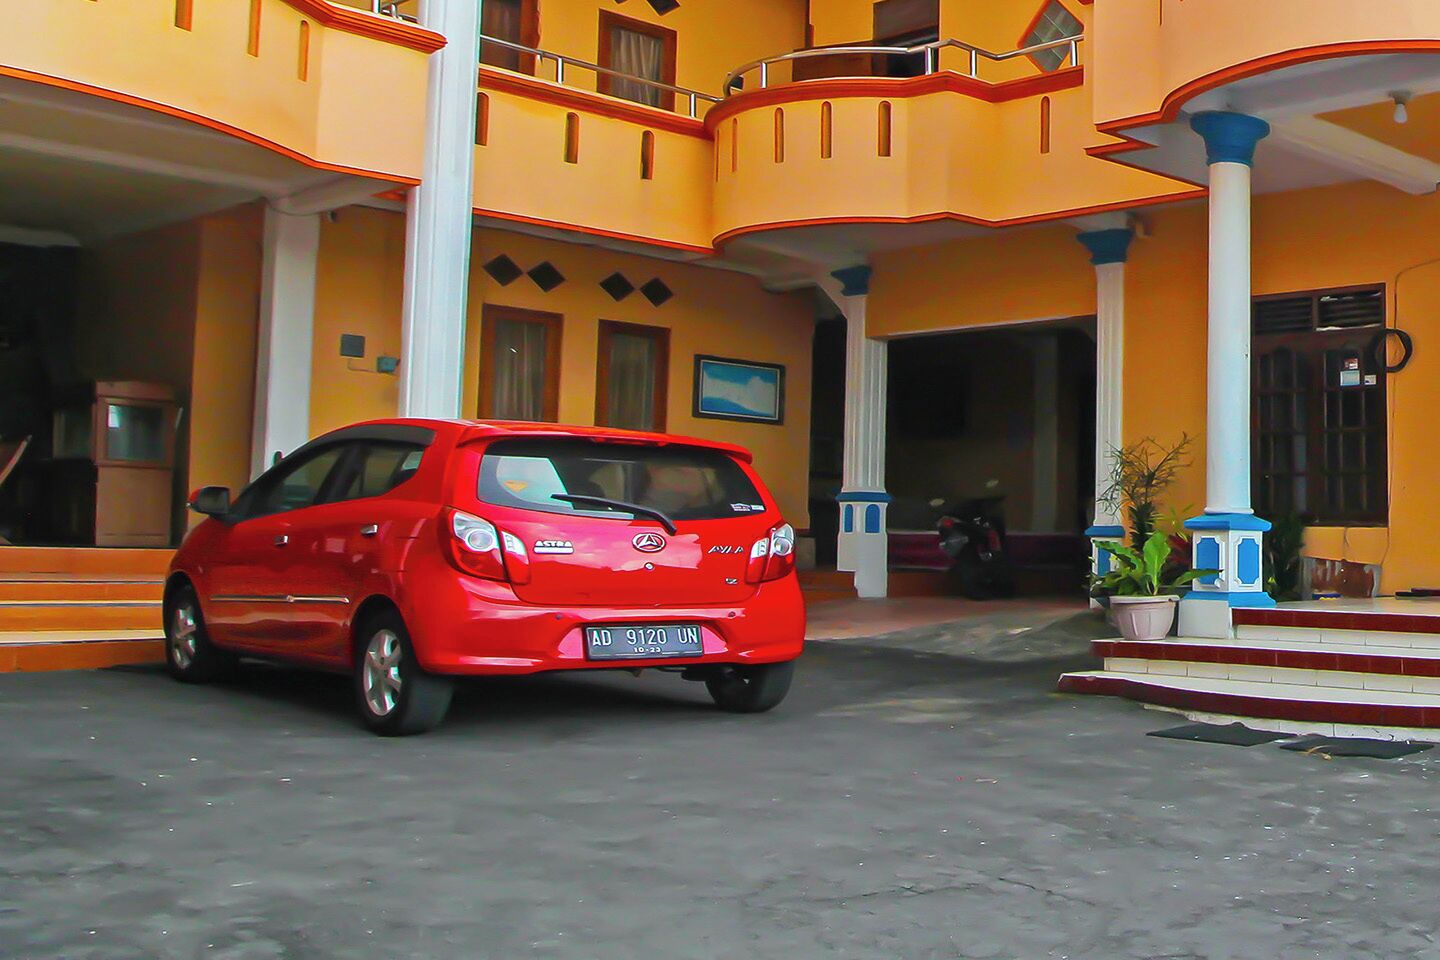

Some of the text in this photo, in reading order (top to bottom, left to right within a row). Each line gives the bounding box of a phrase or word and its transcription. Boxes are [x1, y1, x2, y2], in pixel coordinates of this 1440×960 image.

[592, 627, 698, 646] AD 9120 UN
